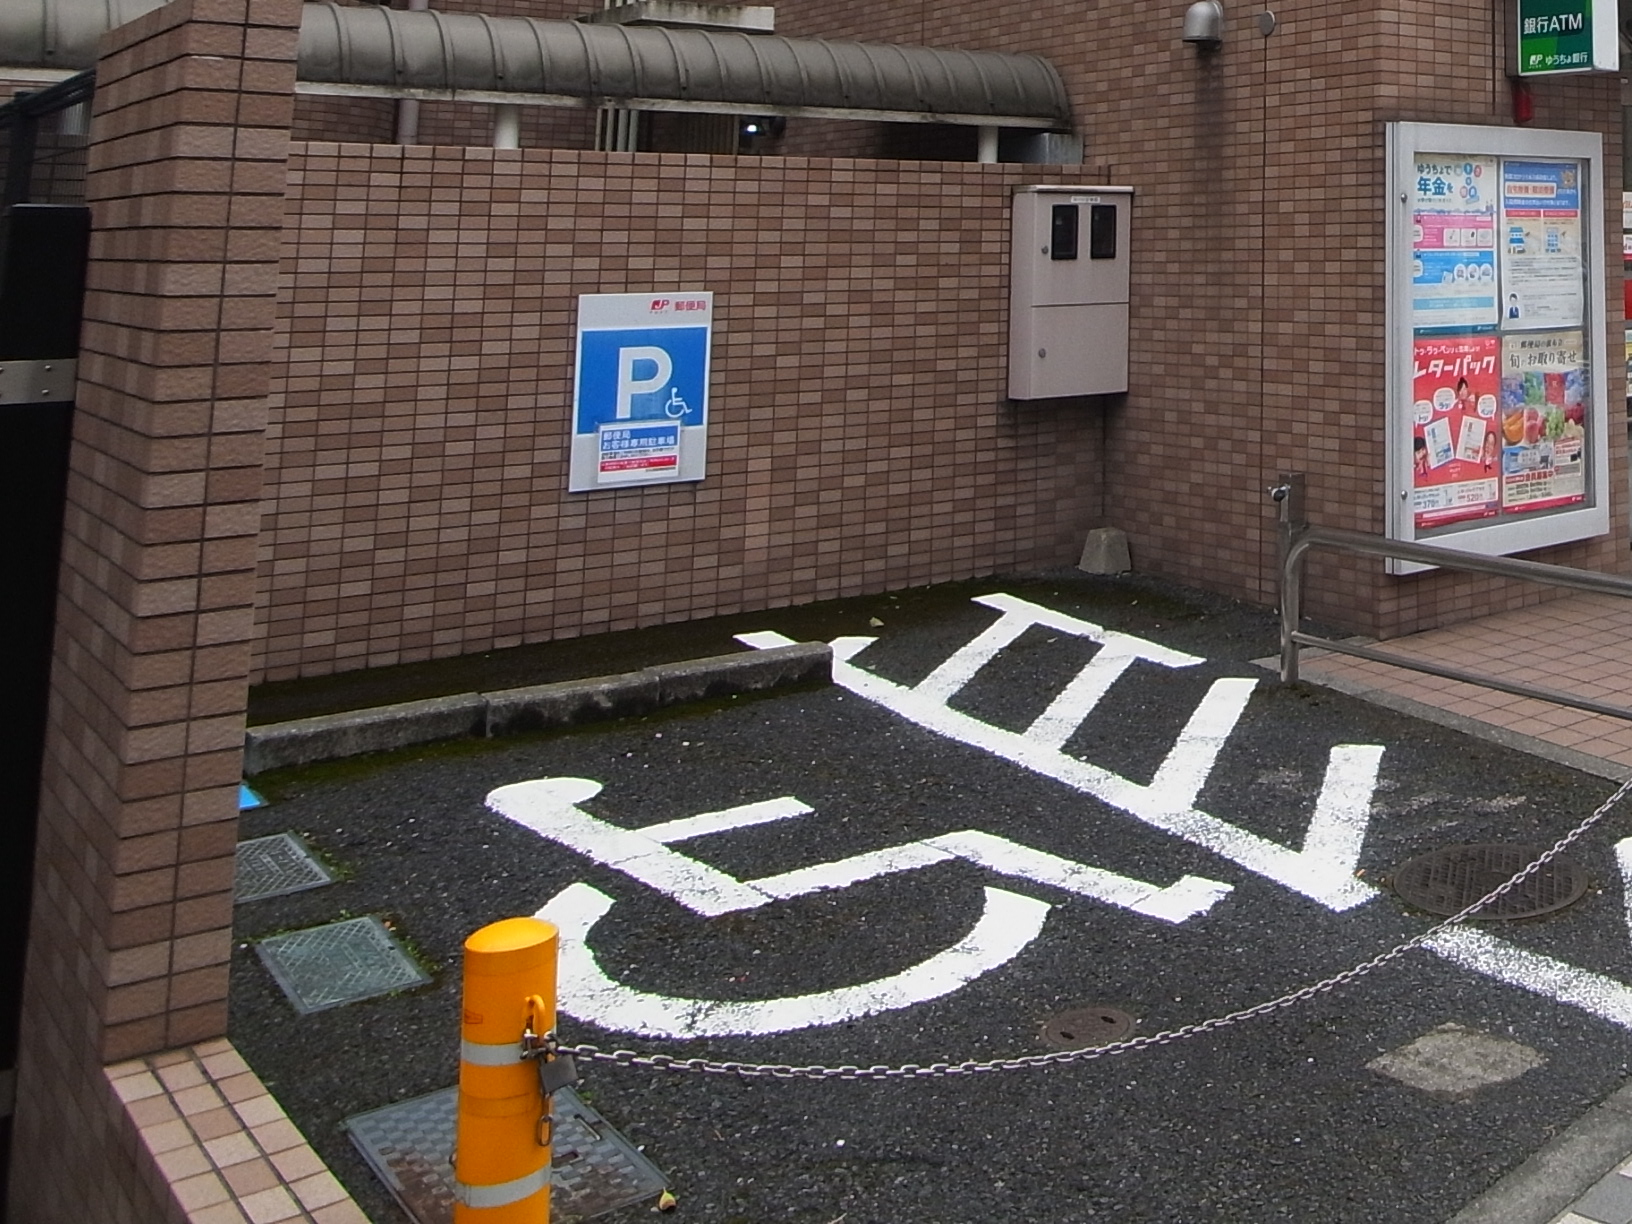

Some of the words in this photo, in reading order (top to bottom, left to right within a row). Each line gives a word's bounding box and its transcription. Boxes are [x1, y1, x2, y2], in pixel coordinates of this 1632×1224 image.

[1523, 13, 1583, 35] 銀行ATM
[1545, 52, 1588, 67] ゆうちょ銀行
[1417, 163, 1452, 175] ゆうちょで
[1417, 176, 1453, 196] 年金を
[675, 300, 706, 311] 郵便局
[1414, 355, 1496, 378] レターパック
[616, 346, 673, 419] P
[602, 435, 675, 450] お客様専用駐車場
[603, 430, 631, 441] 郵便局
